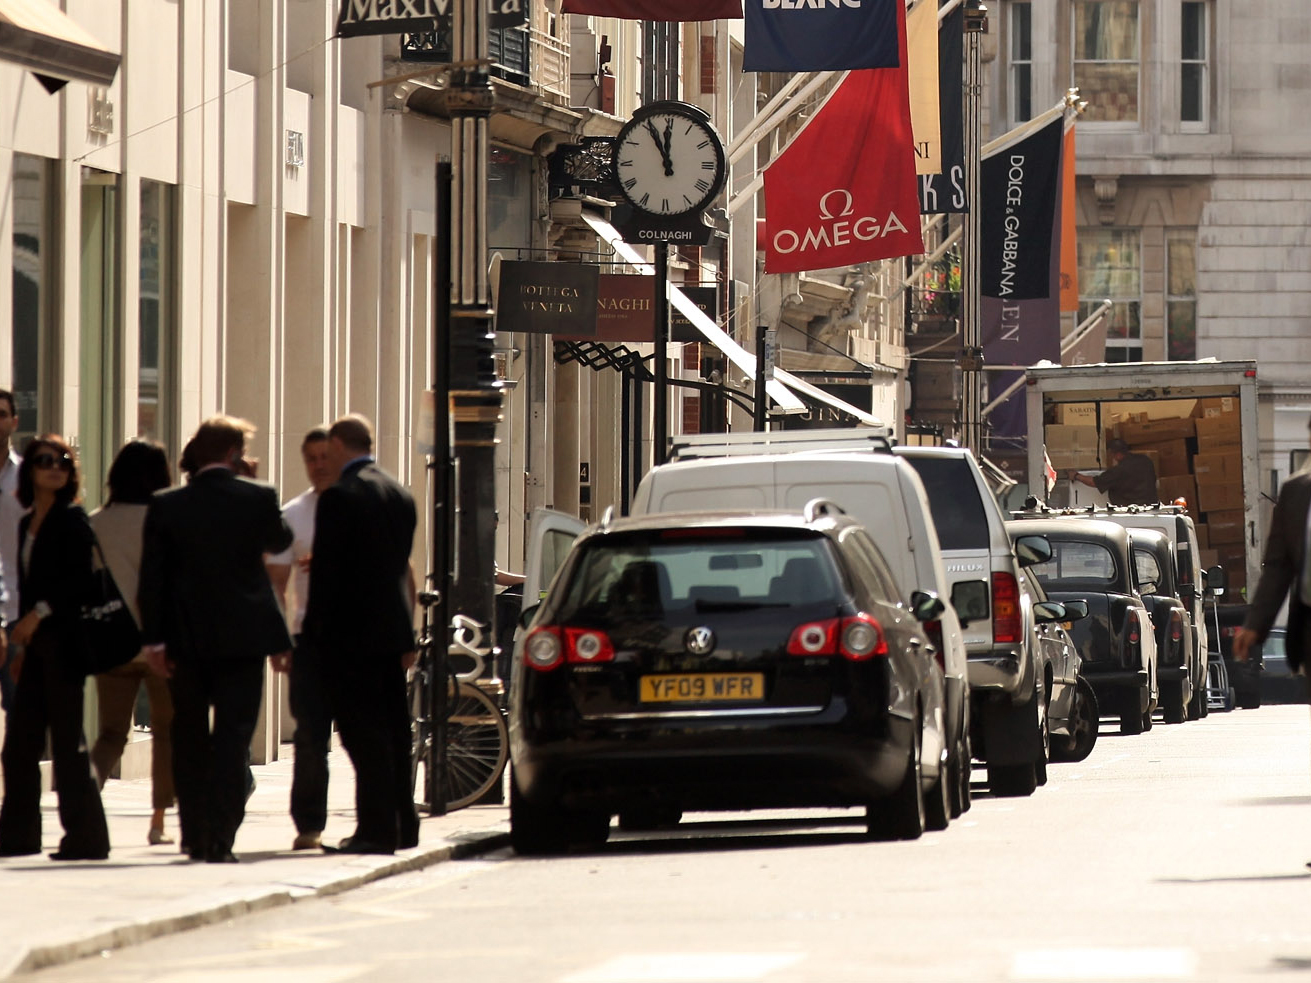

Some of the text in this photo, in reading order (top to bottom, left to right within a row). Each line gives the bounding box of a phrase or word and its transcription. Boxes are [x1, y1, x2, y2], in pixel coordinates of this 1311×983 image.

[638, 230, 693, 240] COLNAGHI
[773, 211, 908, 254] OMEGA
[998, 155, 1025, 297] DOLCE & GABBANA
[1000, 299, 1020, 343] EN
[947, 564, 983, 572] HILUX
[650, 676, 754, 698] YF09 WFR
